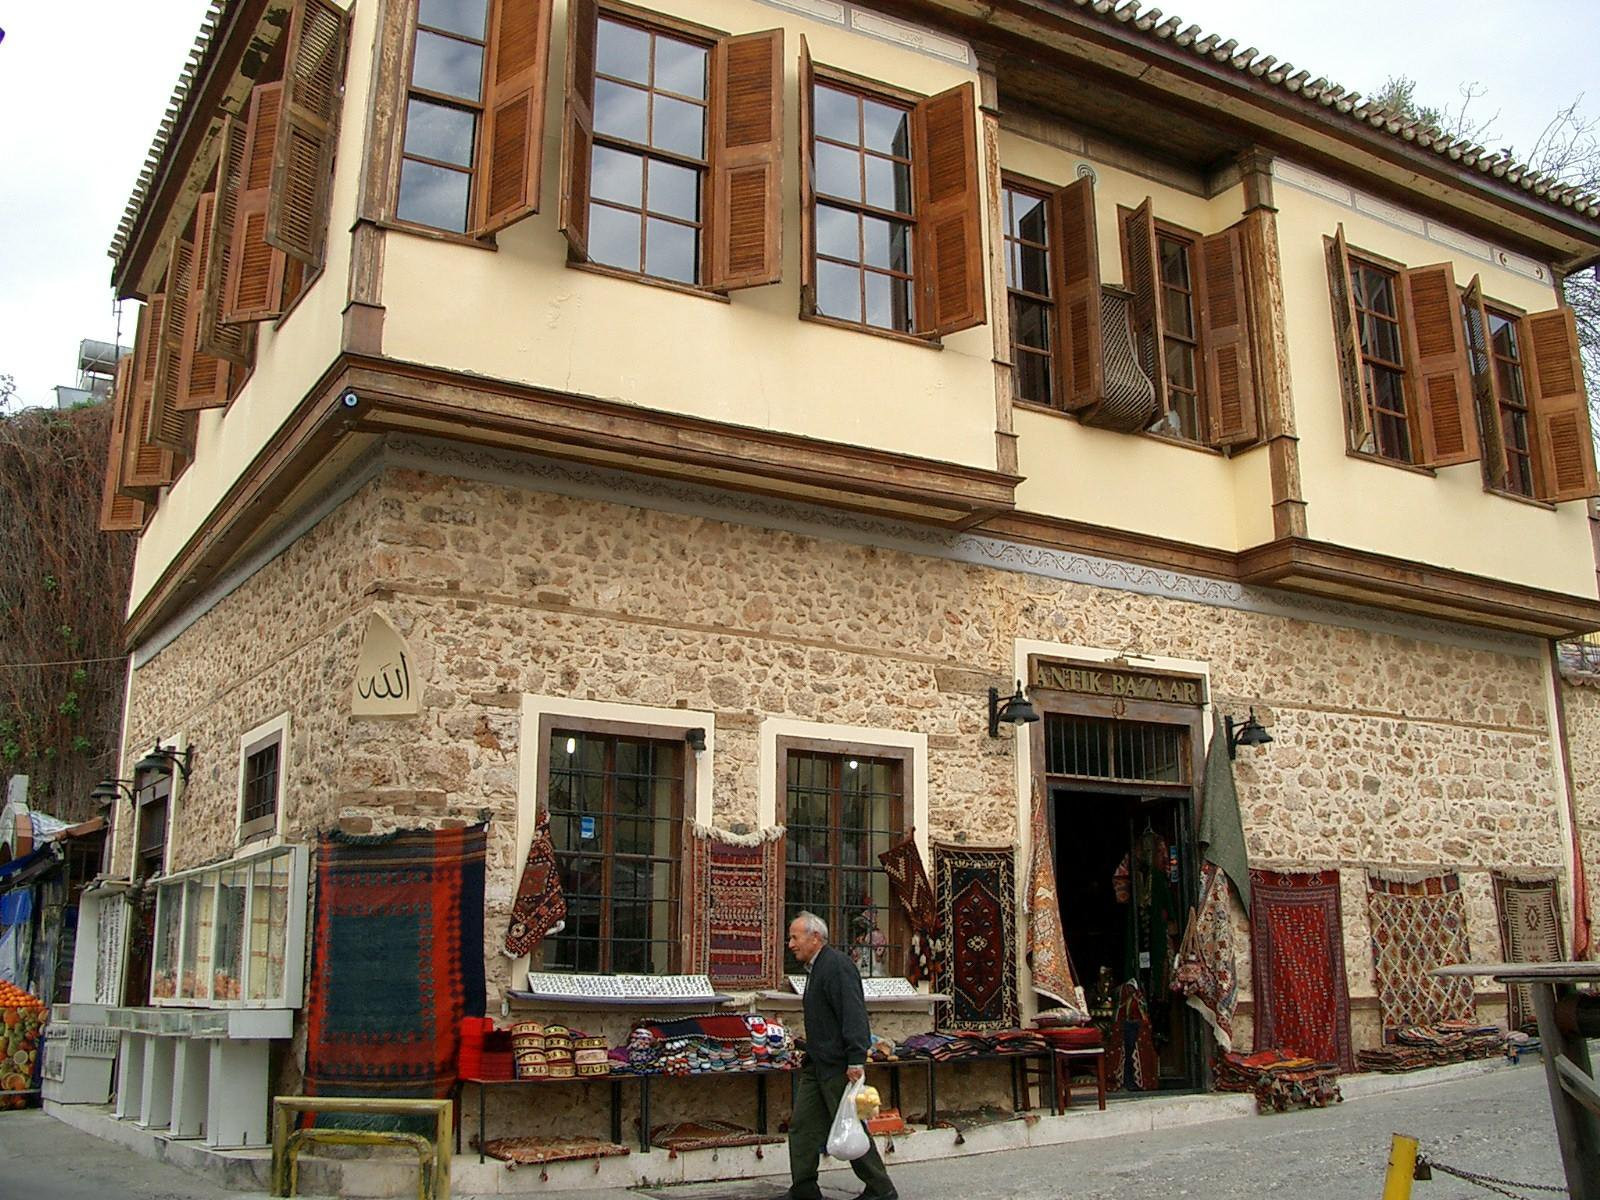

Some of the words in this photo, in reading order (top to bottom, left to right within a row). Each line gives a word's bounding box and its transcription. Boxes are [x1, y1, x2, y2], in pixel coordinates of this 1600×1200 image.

[358, 651, 409, 700] الله
[1036, 665, 1102, 693] ANTIK
[1113, 674, 1198, 704] BAZAAR
